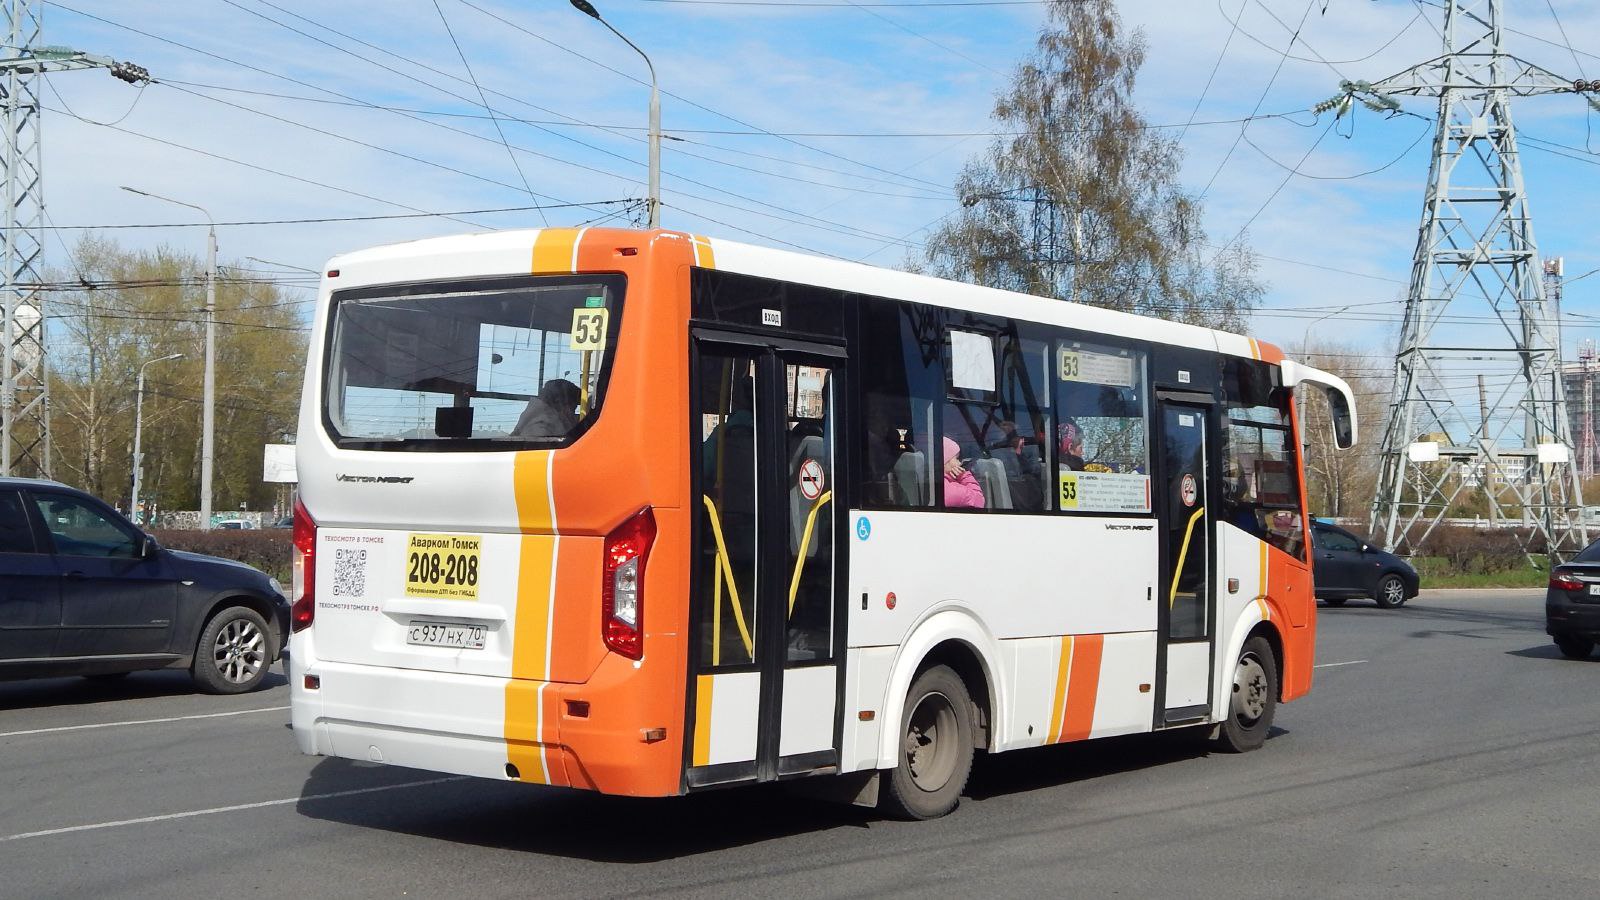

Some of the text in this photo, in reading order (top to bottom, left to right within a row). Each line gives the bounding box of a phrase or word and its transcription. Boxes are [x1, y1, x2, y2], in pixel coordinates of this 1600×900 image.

[764, 312, 780, 325] ВХОД
[575, 314, 604, 344] 53
[1063, 355, 1079, 377] 53
[1062, 481, 1077, 500] 53
[362, 536, 384, 544] ТОМСКЕ
[410, 536, 479, 550] Аварком Томск
[408, 552, 478, 586] 208-208
[468, 626, 481, 641] 70
